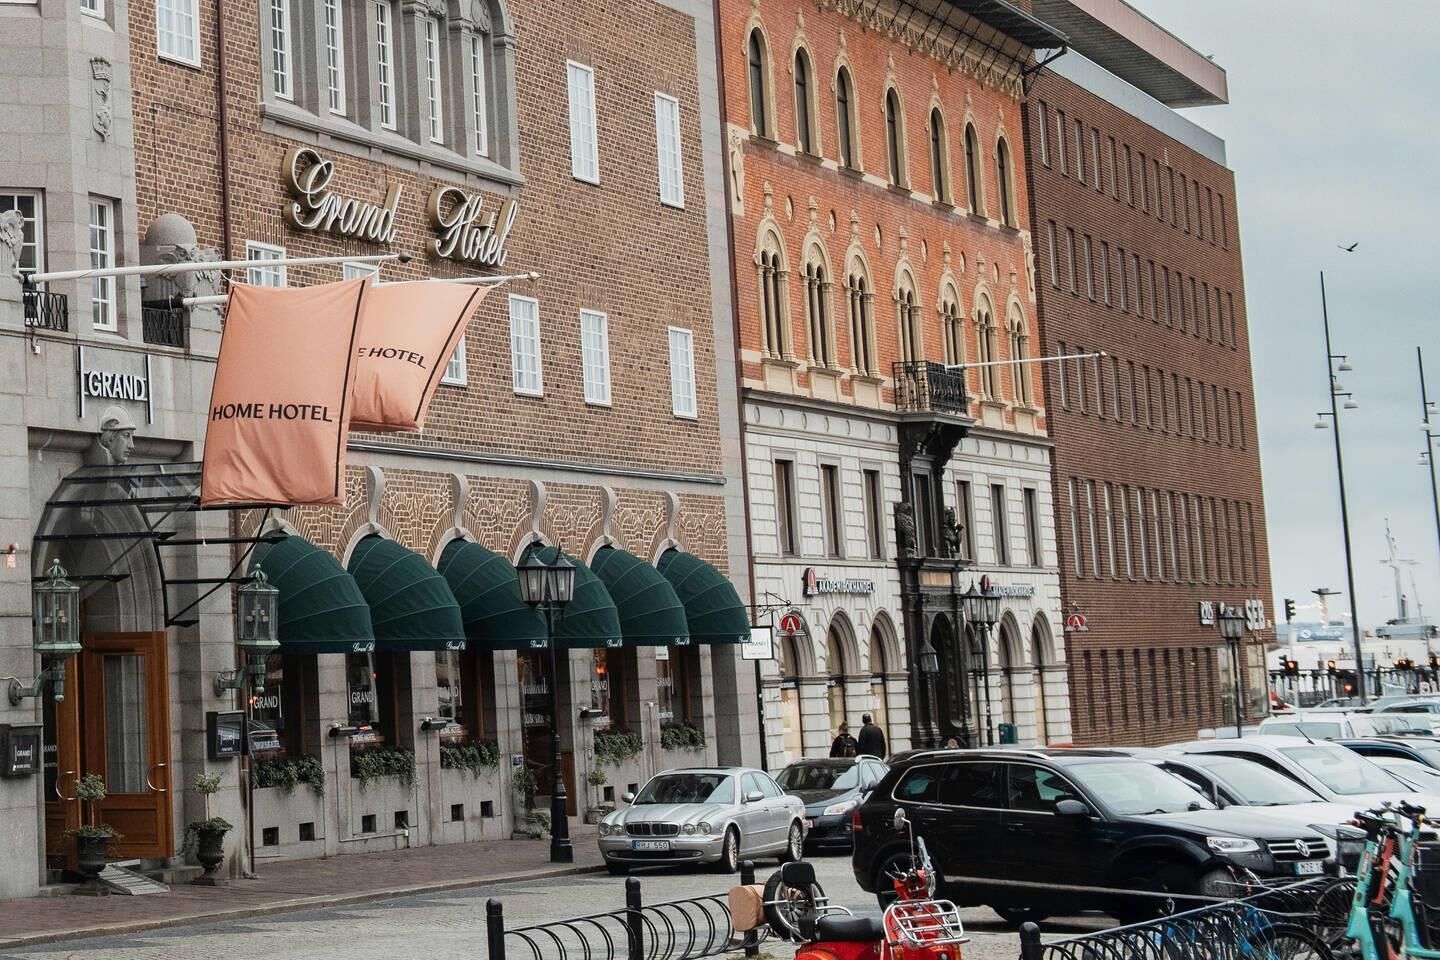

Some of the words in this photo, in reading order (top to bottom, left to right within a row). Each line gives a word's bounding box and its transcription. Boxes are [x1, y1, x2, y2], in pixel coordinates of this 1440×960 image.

[286, 147, 404, 244] Grand
[428, 186, 518, 267] Hotel
[369, 347, 427, 370] HOTEL
[88, 369, 146, 401] GRAND
[212, 403, 264, 422] HOME
[268, 403, 333, 423] HOTEL
[253, 695, 279, 709] GRAND
[351, 691, 374, 704] GRAND
